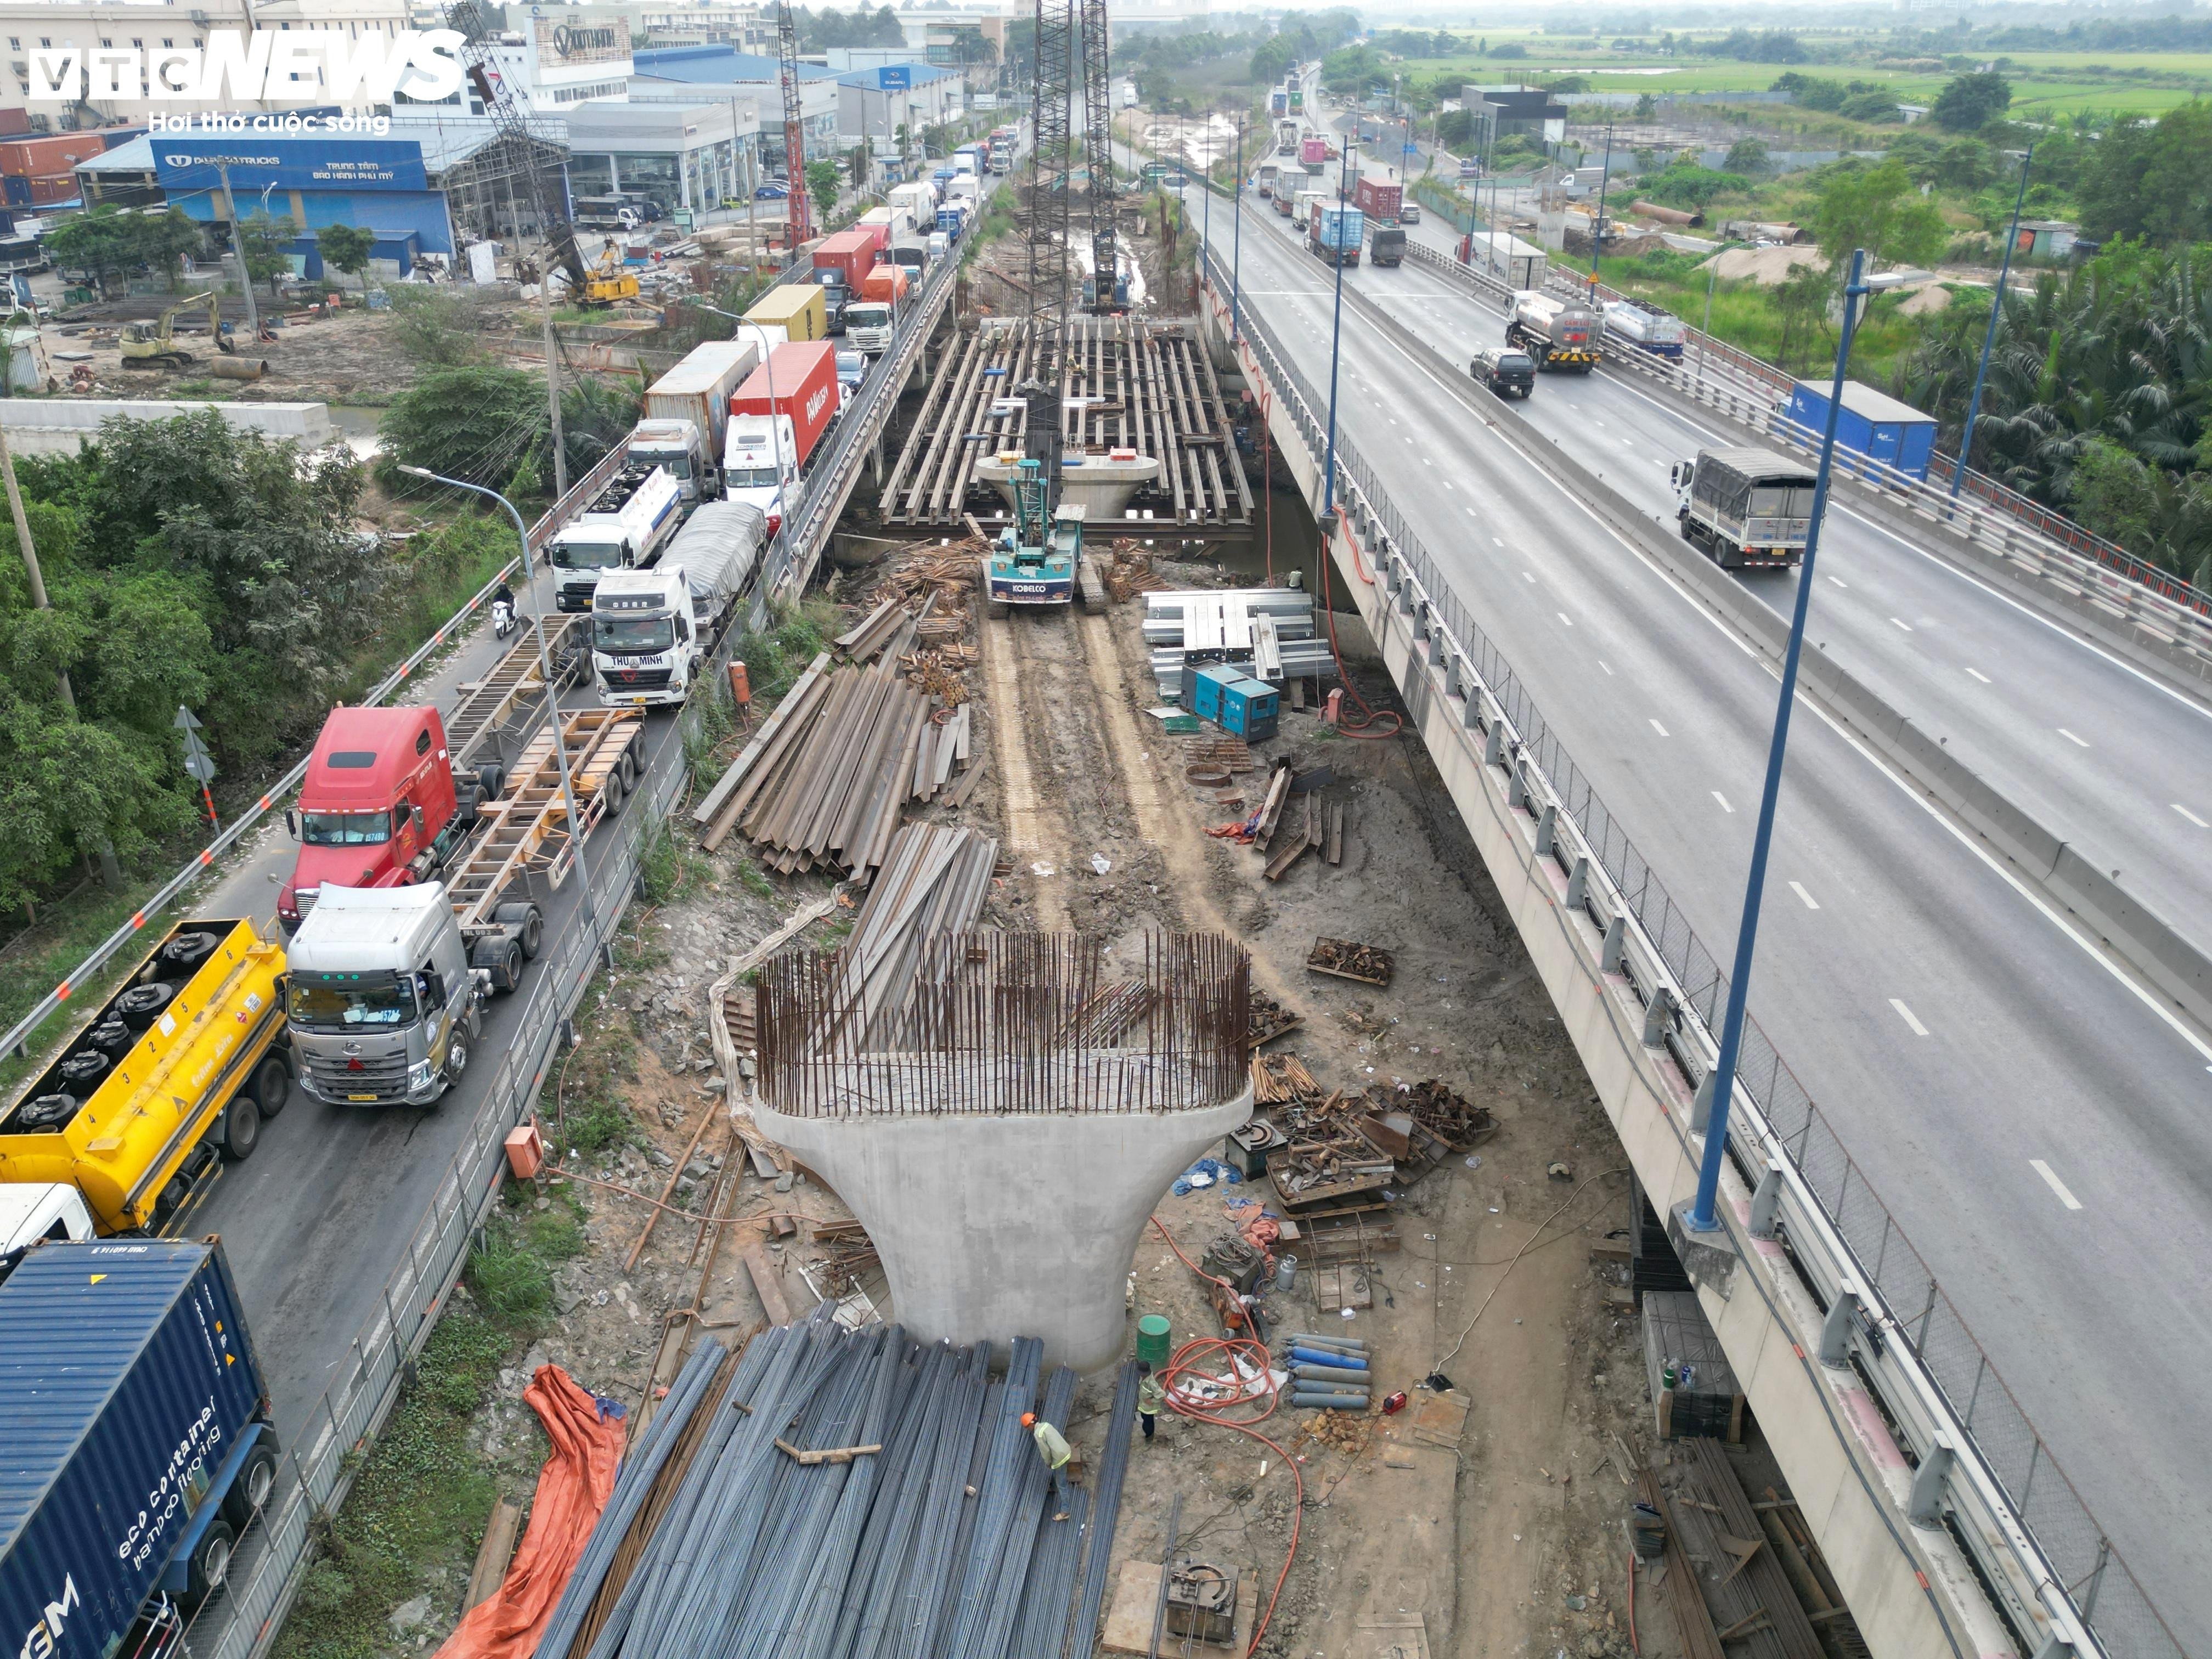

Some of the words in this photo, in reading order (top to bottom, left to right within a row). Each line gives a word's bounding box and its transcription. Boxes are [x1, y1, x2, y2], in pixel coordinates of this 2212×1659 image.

[357, 161, 379, 170] TÂM
[1012, 584, 1046, 592] KOBELCO
[639, 656, 663, 665] MINH
[226, 950, 233, 960] 6
[181, 1001, 189, 1013] 5
[149, 1041, 156, 1053] 2
[122, 1072, 130, 1085] 3
[88, 1114, 96, 1125] 4
[177, 1425, 221, 1492] flooring
[119, 1511, 147, 1559] eco
[150, 1395, 216, 1508] container
[20, 1571, 80, 1659] GM
